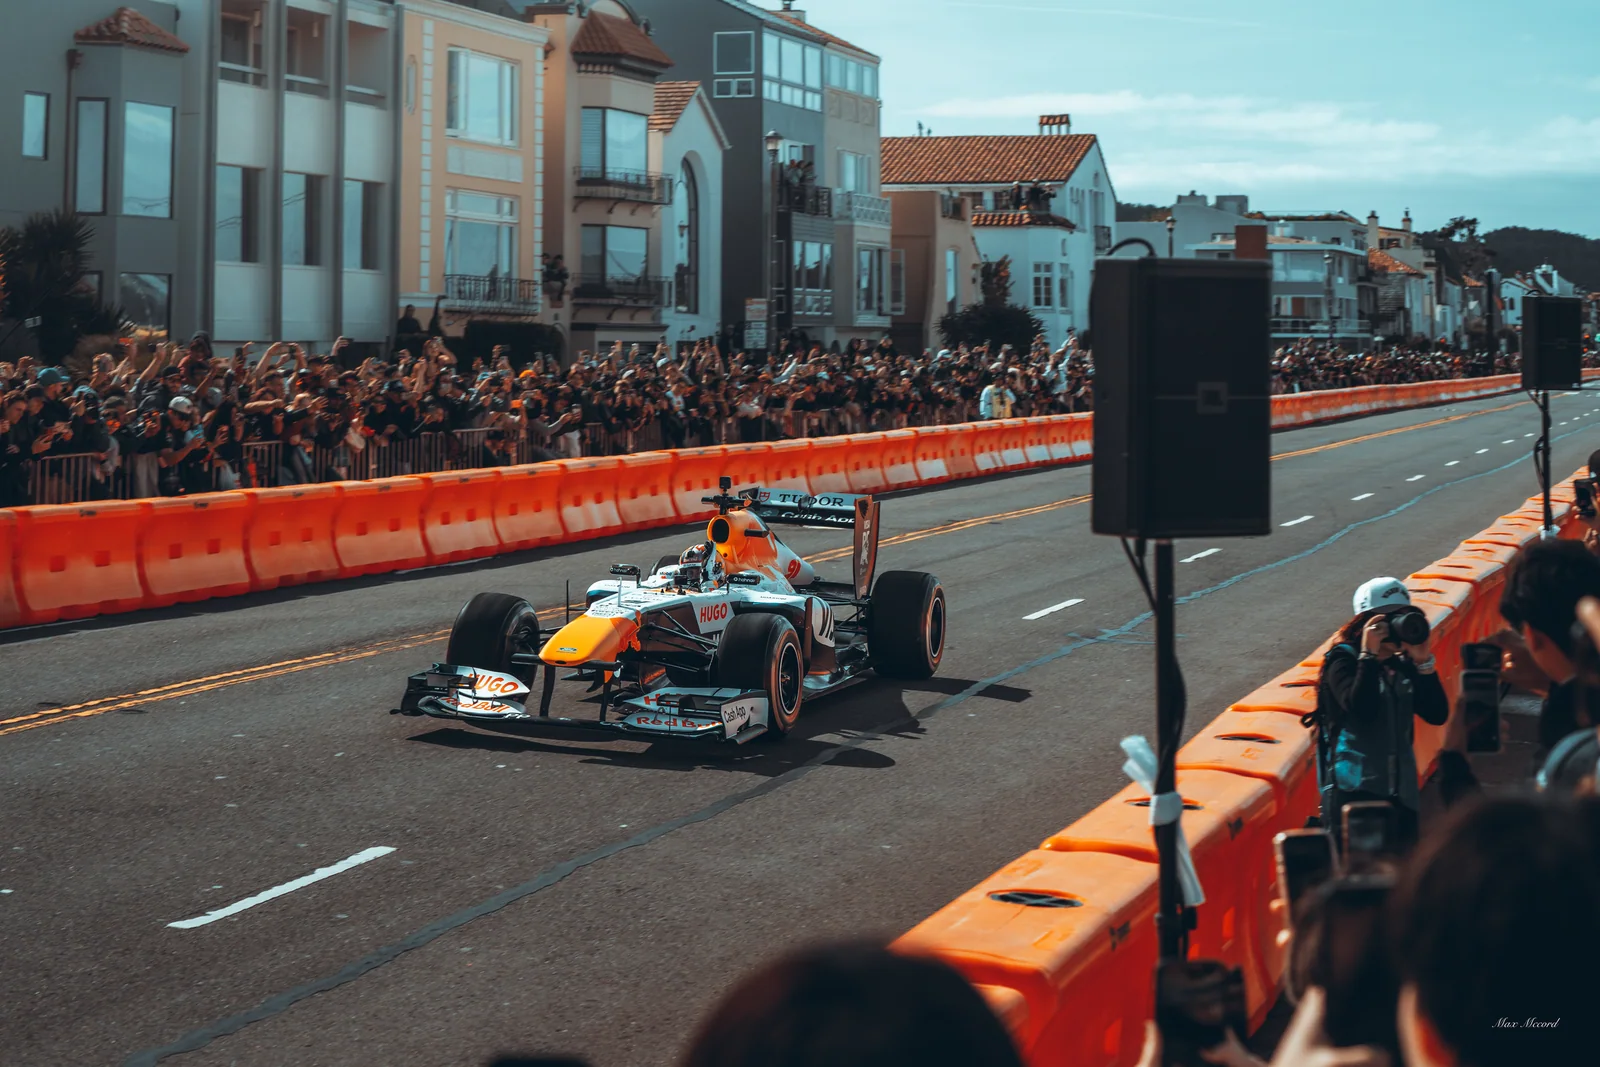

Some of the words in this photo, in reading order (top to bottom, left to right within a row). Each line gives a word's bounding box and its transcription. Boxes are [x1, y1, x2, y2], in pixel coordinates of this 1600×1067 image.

[779, 493, 844, 507] TUDOR
[700, 602, 728, 624] HUGO
[636, 716, 678, 727] Red
[724, 708, 737, 724] Cash
[736, 706, 746, 720] App
